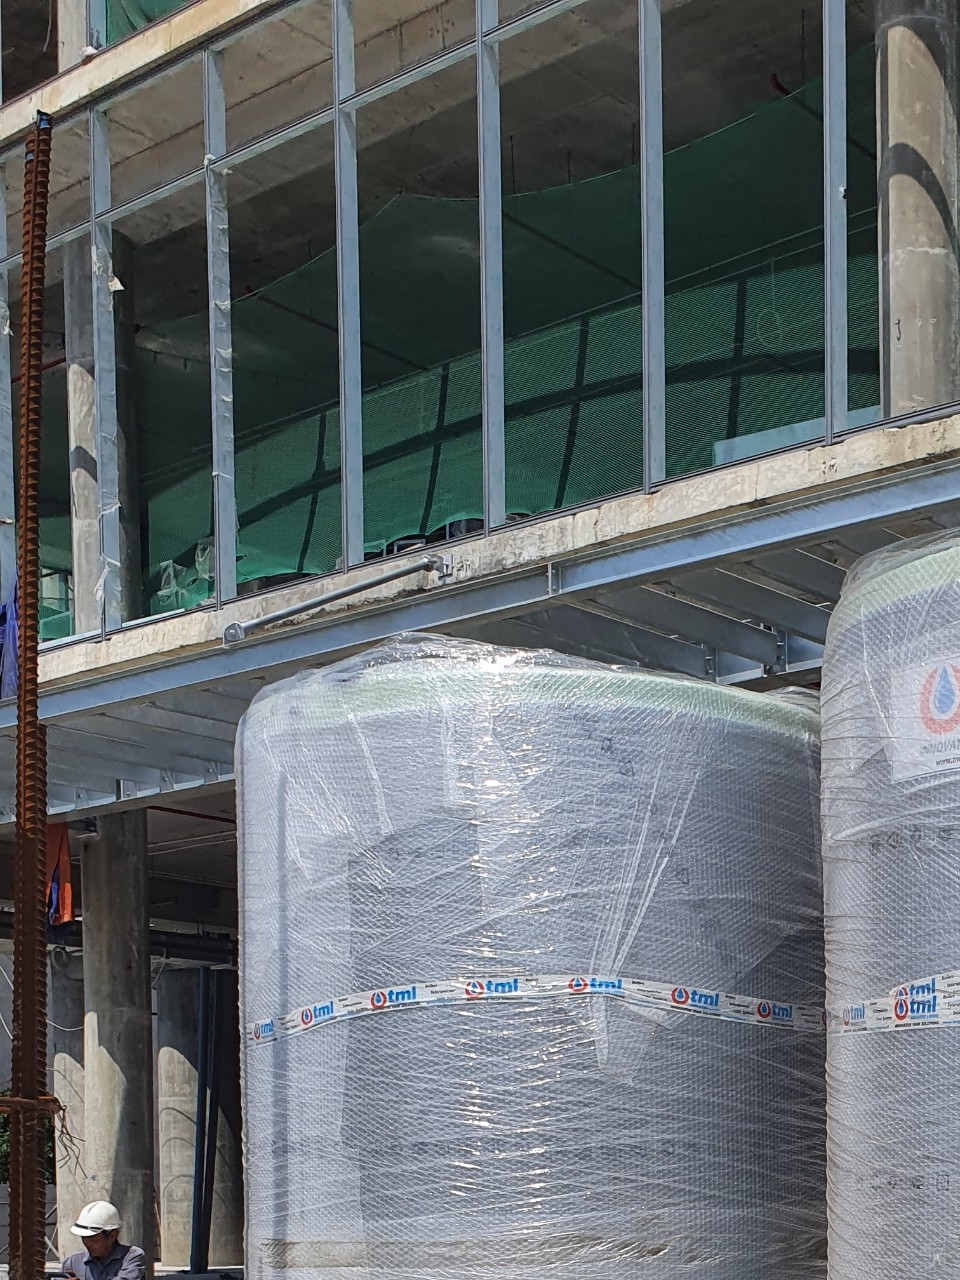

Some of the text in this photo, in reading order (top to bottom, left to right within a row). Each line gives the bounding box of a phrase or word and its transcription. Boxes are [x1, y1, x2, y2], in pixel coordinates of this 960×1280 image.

[387, 986, 417, 1003] tml
[485, 978, 518, 994] tml
[909, 978, 936, 996] tml
[690, 990, 720, 1007] tml
[910, 996, 937, 1014] tml
[312, 1001, 334, 1019] tml
[772, 1003, 793, 1018] tml
